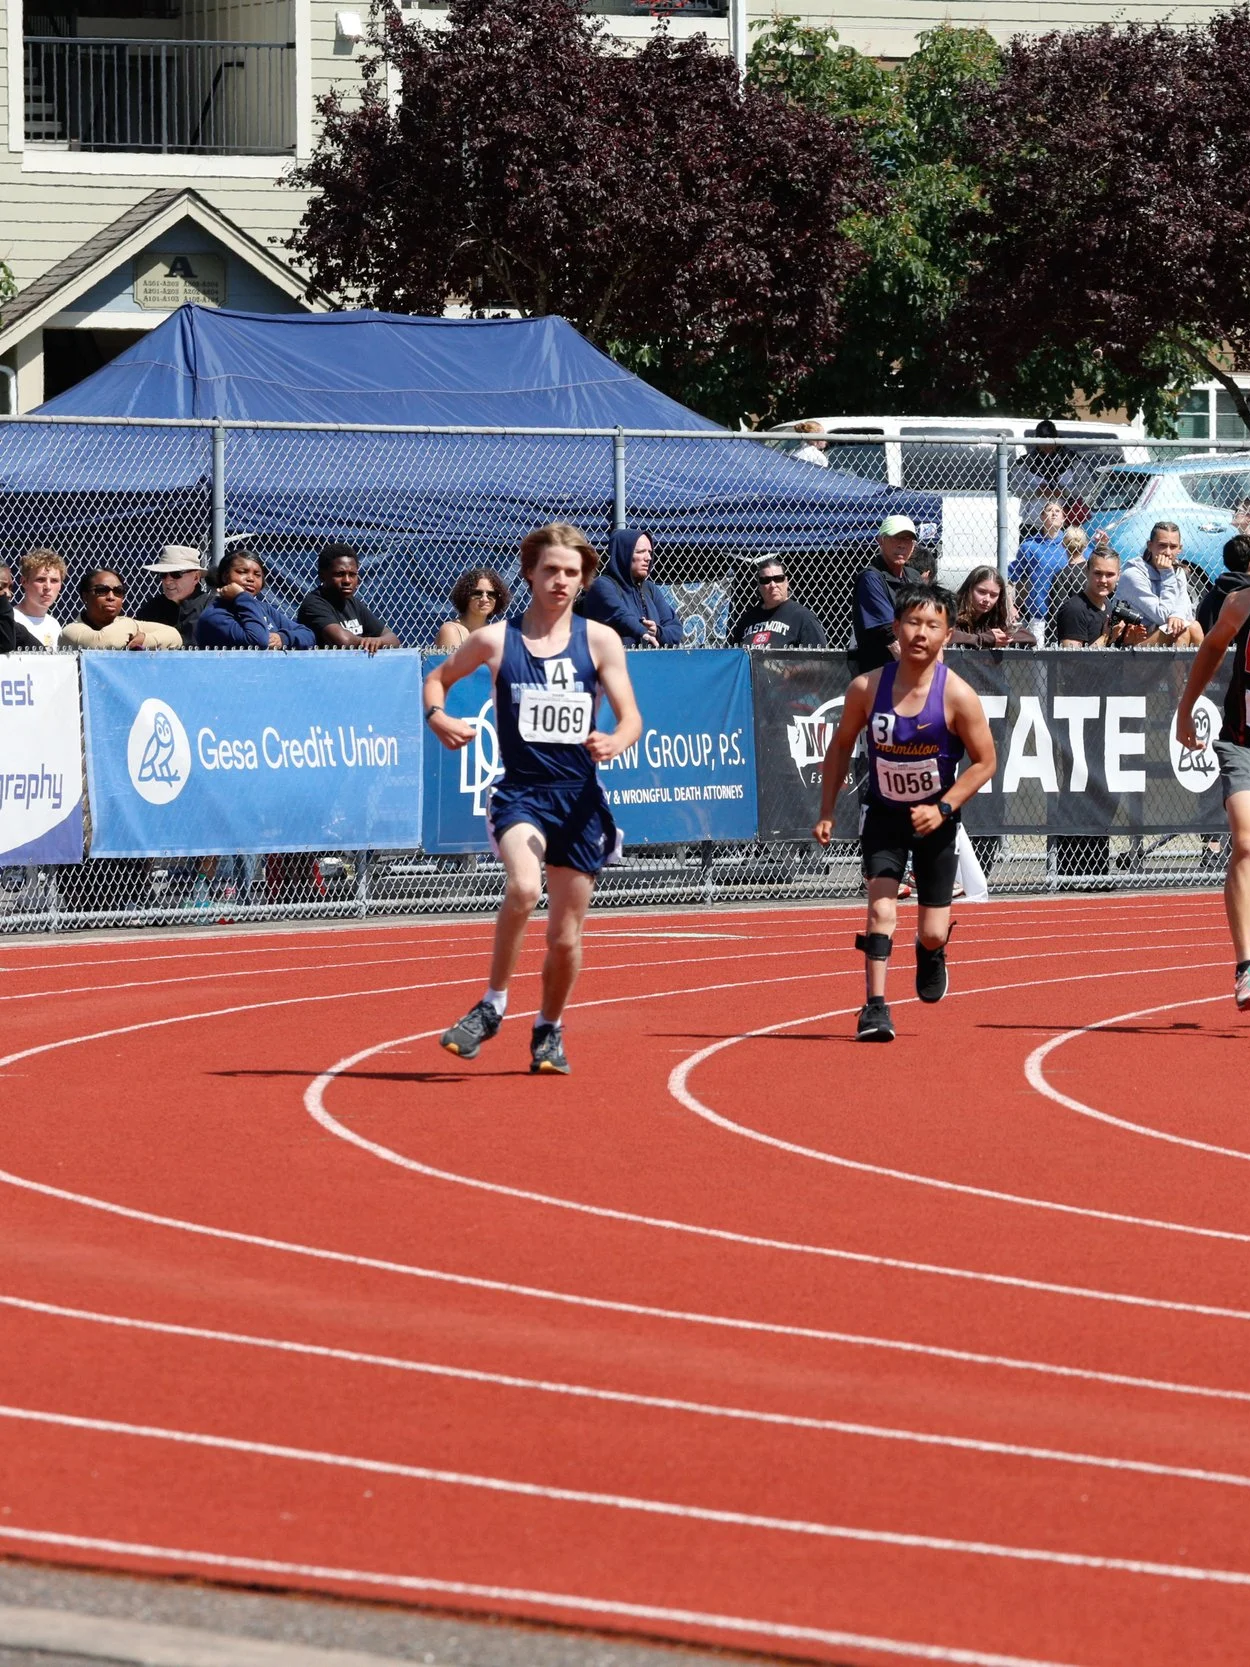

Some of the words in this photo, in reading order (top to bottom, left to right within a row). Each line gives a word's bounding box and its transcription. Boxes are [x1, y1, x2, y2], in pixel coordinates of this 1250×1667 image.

[164, 256, 198, 278] A
[551, 661, 569, 690] 4
[529, 704, 585, 734] 1069
[877, 715, 889, 744] 3
[197, 727, 259, 770] Gesa
[262, 725, 337, 769] Credit
[338, 724, 398, 767] Union
[977, 695, 1147, 793] TATE
[613, 791, 621, 805] &
[622, 787, 672, 804] WRONGFUL
[674, 786, 701, 801] DEATH
[703, 784, 744, 800] ATTORNEYS
[883, 770, 934, 795] 1058
